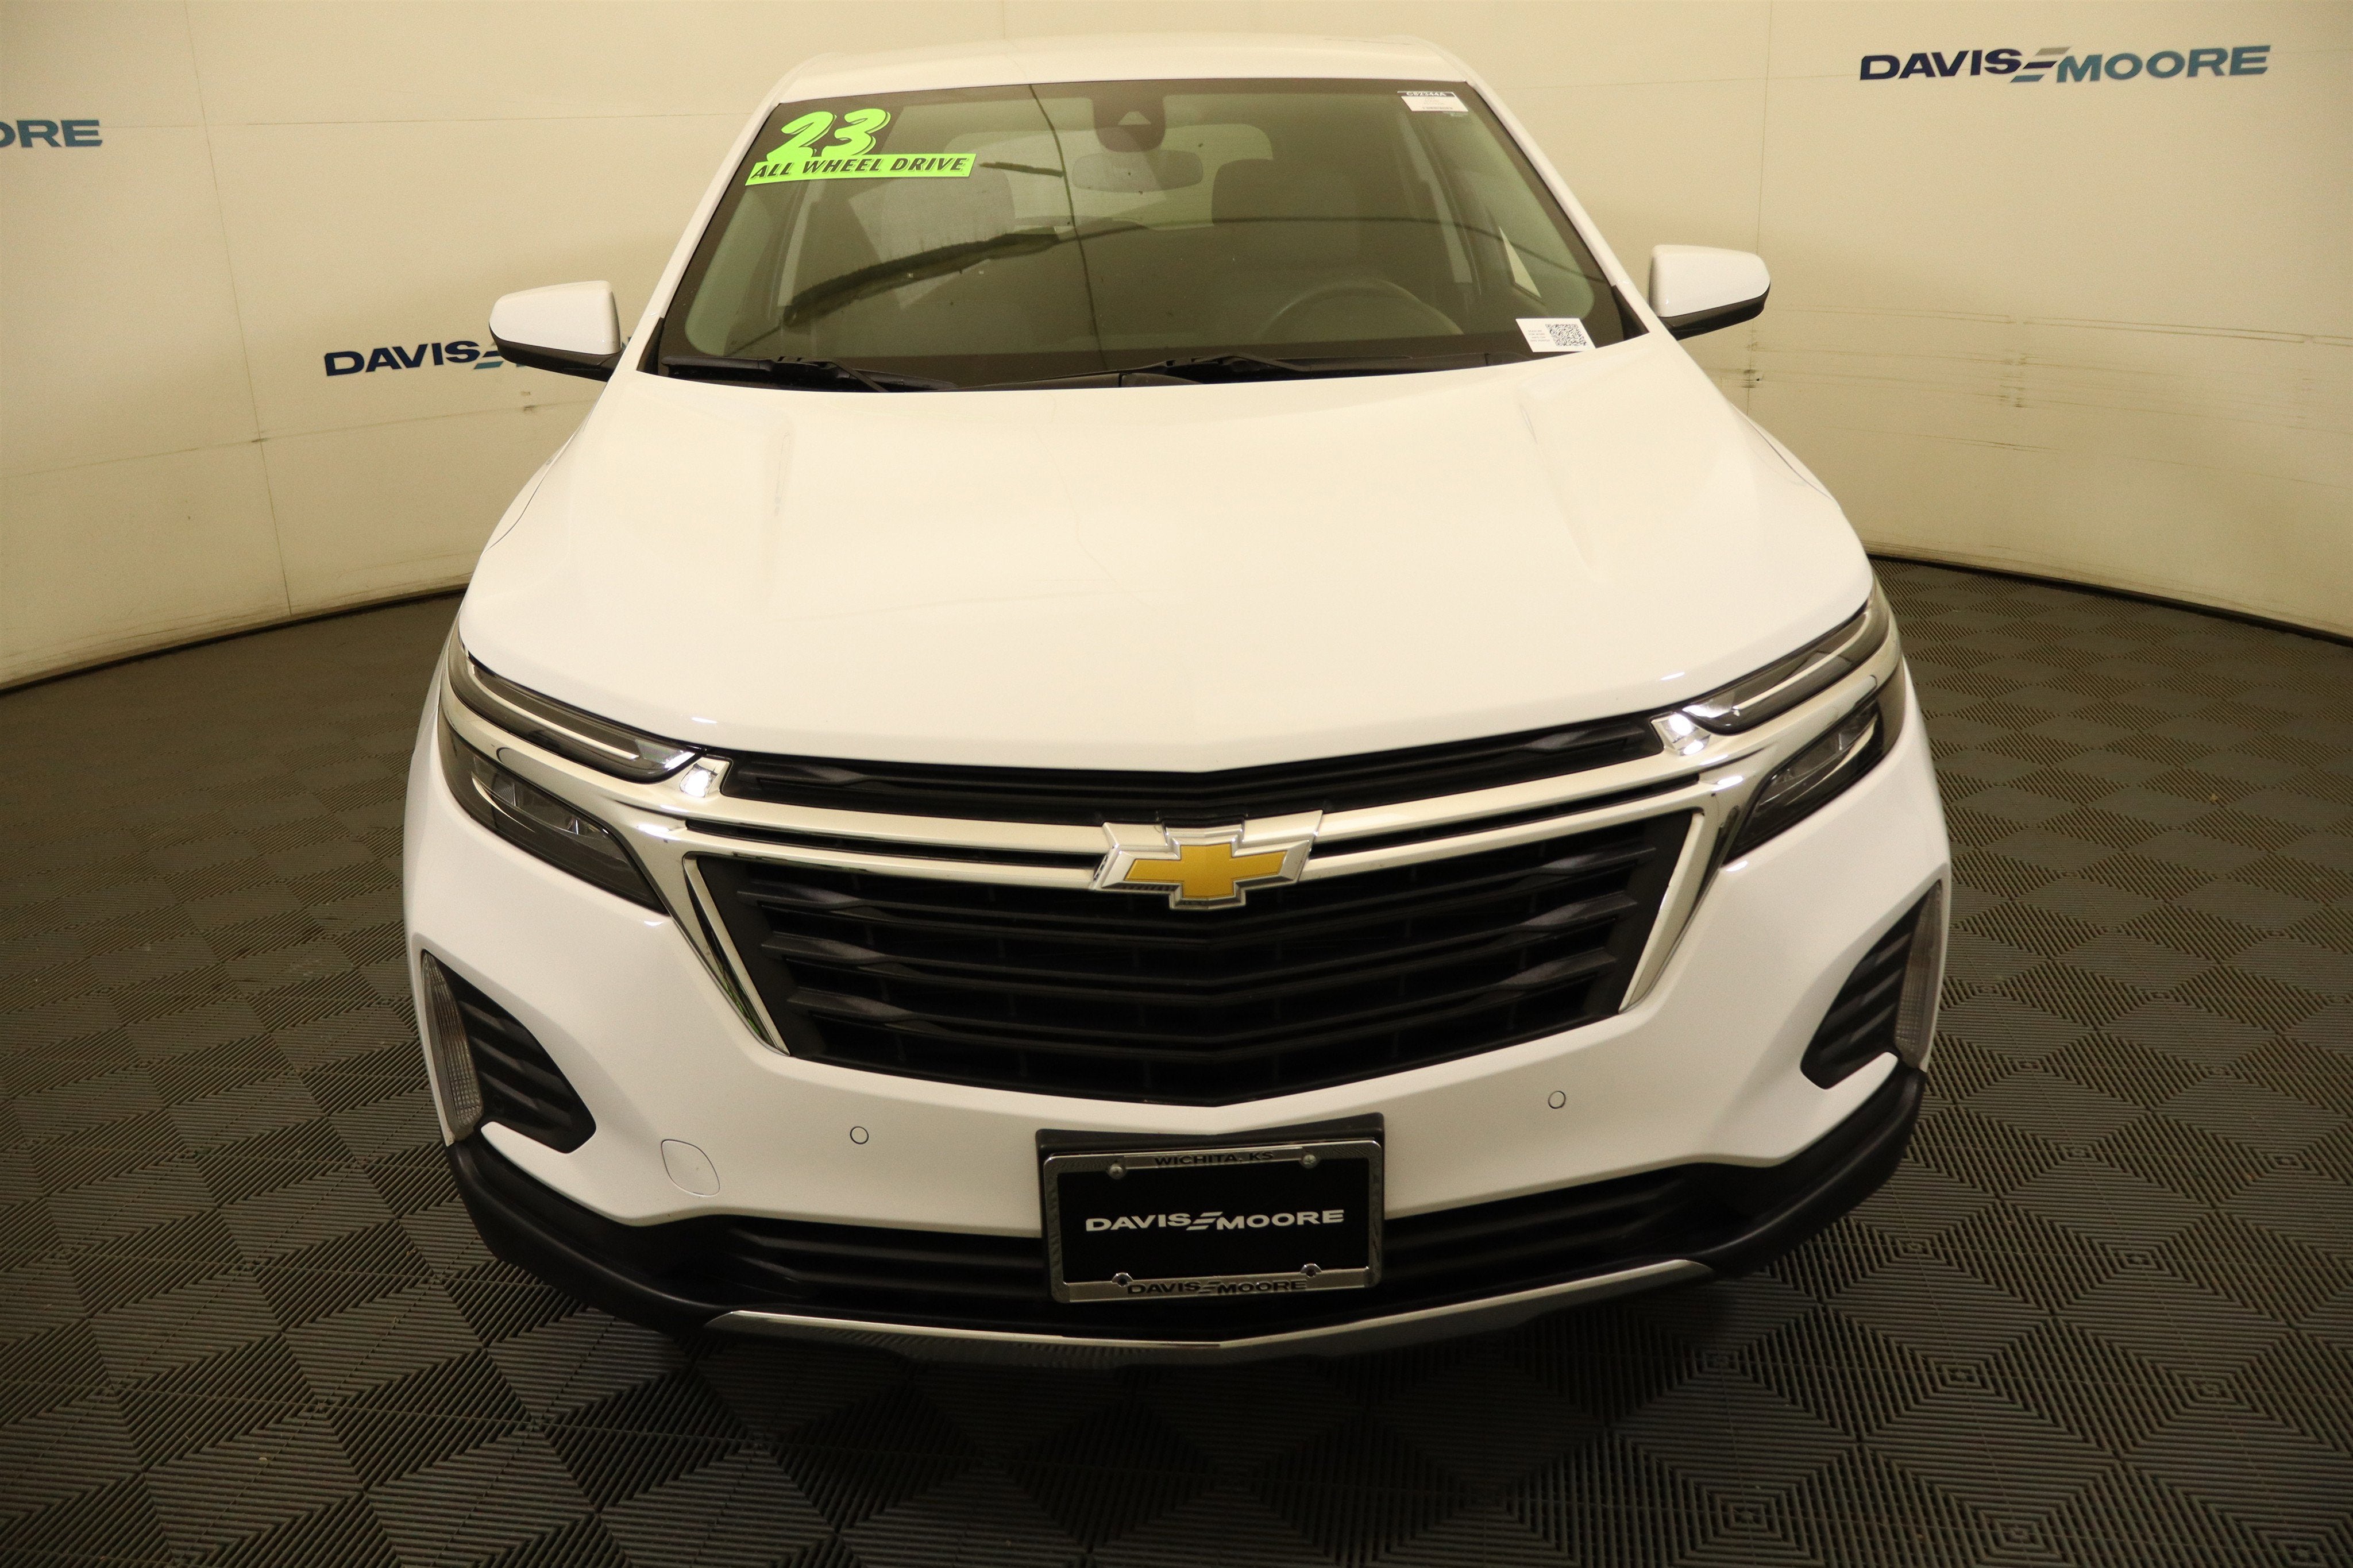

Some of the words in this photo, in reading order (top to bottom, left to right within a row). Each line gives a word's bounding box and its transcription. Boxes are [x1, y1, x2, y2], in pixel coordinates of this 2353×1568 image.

[1860, 48, 2025, 82] DAVIS
[2056, 45, 2271, 83] MOORE
[767, 108, 891, 162] 23
[750, 161, 793, 180] ALL
[802, 157, 882, 174] WHEEL
[889, 156, 970, 172] DRIVE
[323, 339, 481, 377] DAVIS
[1249, 1151, 1274, 1161] KS
[1085, 1212, 1192, 1232] DAVIS
[1216, 1209, 1345, 1230] MOORE
[1127, 1281, 1201, 1293] DAVIS
[1217, 1279, 1307, 1294] MOORE
